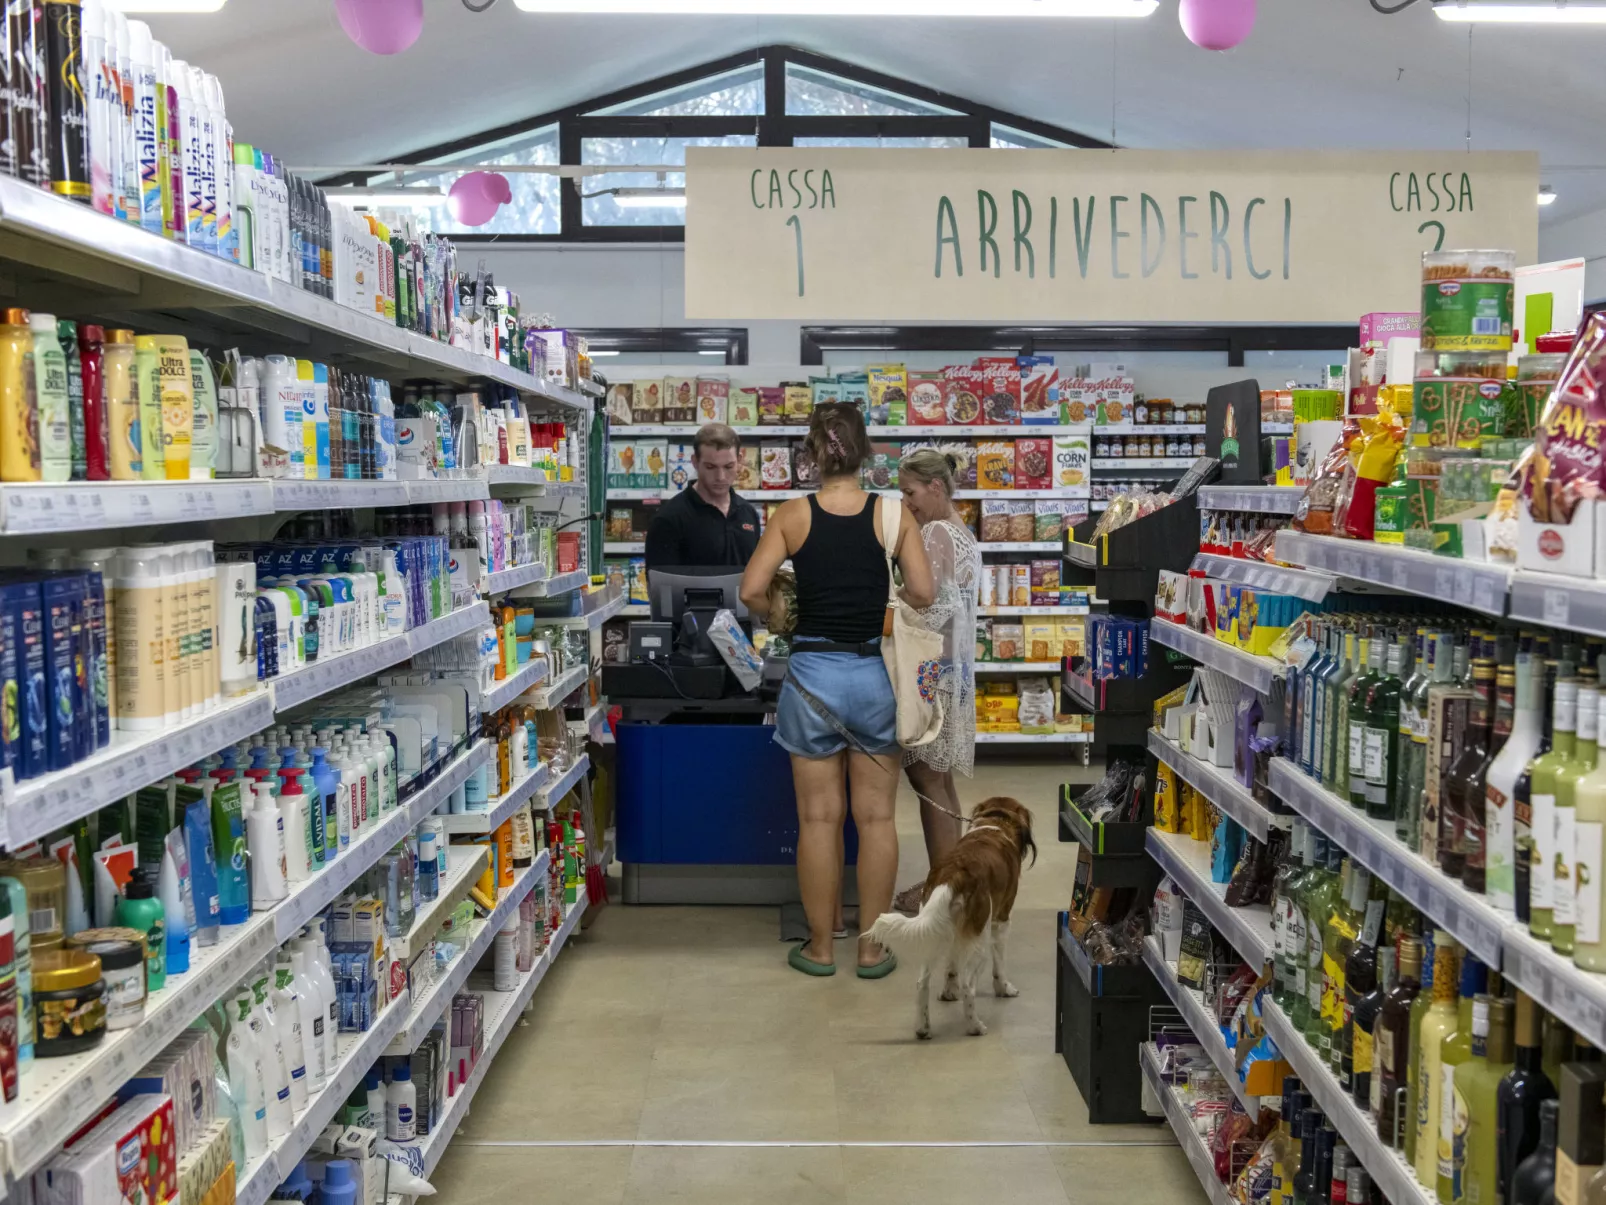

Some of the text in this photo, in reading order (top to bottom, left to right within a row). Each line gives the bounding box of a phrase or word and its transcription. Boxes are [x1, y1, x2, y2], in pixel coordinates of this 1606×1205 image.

[134, 95, 157, 183] Malizia
[200, 142, 217, 216] Malizia
[750, 168, 836, 210] CASSA
[1389, 171, 1475, 213] CASSA
[934, 189, 1292, 281] ARRIVEDERCI
[785, 214, 805, 298] 1
[161, 357, 183, 367] Ultra
[159, 367, 186, 377] DOLCE
[1056, 453, 1086, 463] CORN
[257, 554, 271, 564] AZ
[278, 554, 292, 564] AZ
[300, 553, 314, 564] AZ
[321, 553, 335, 563] AZ
